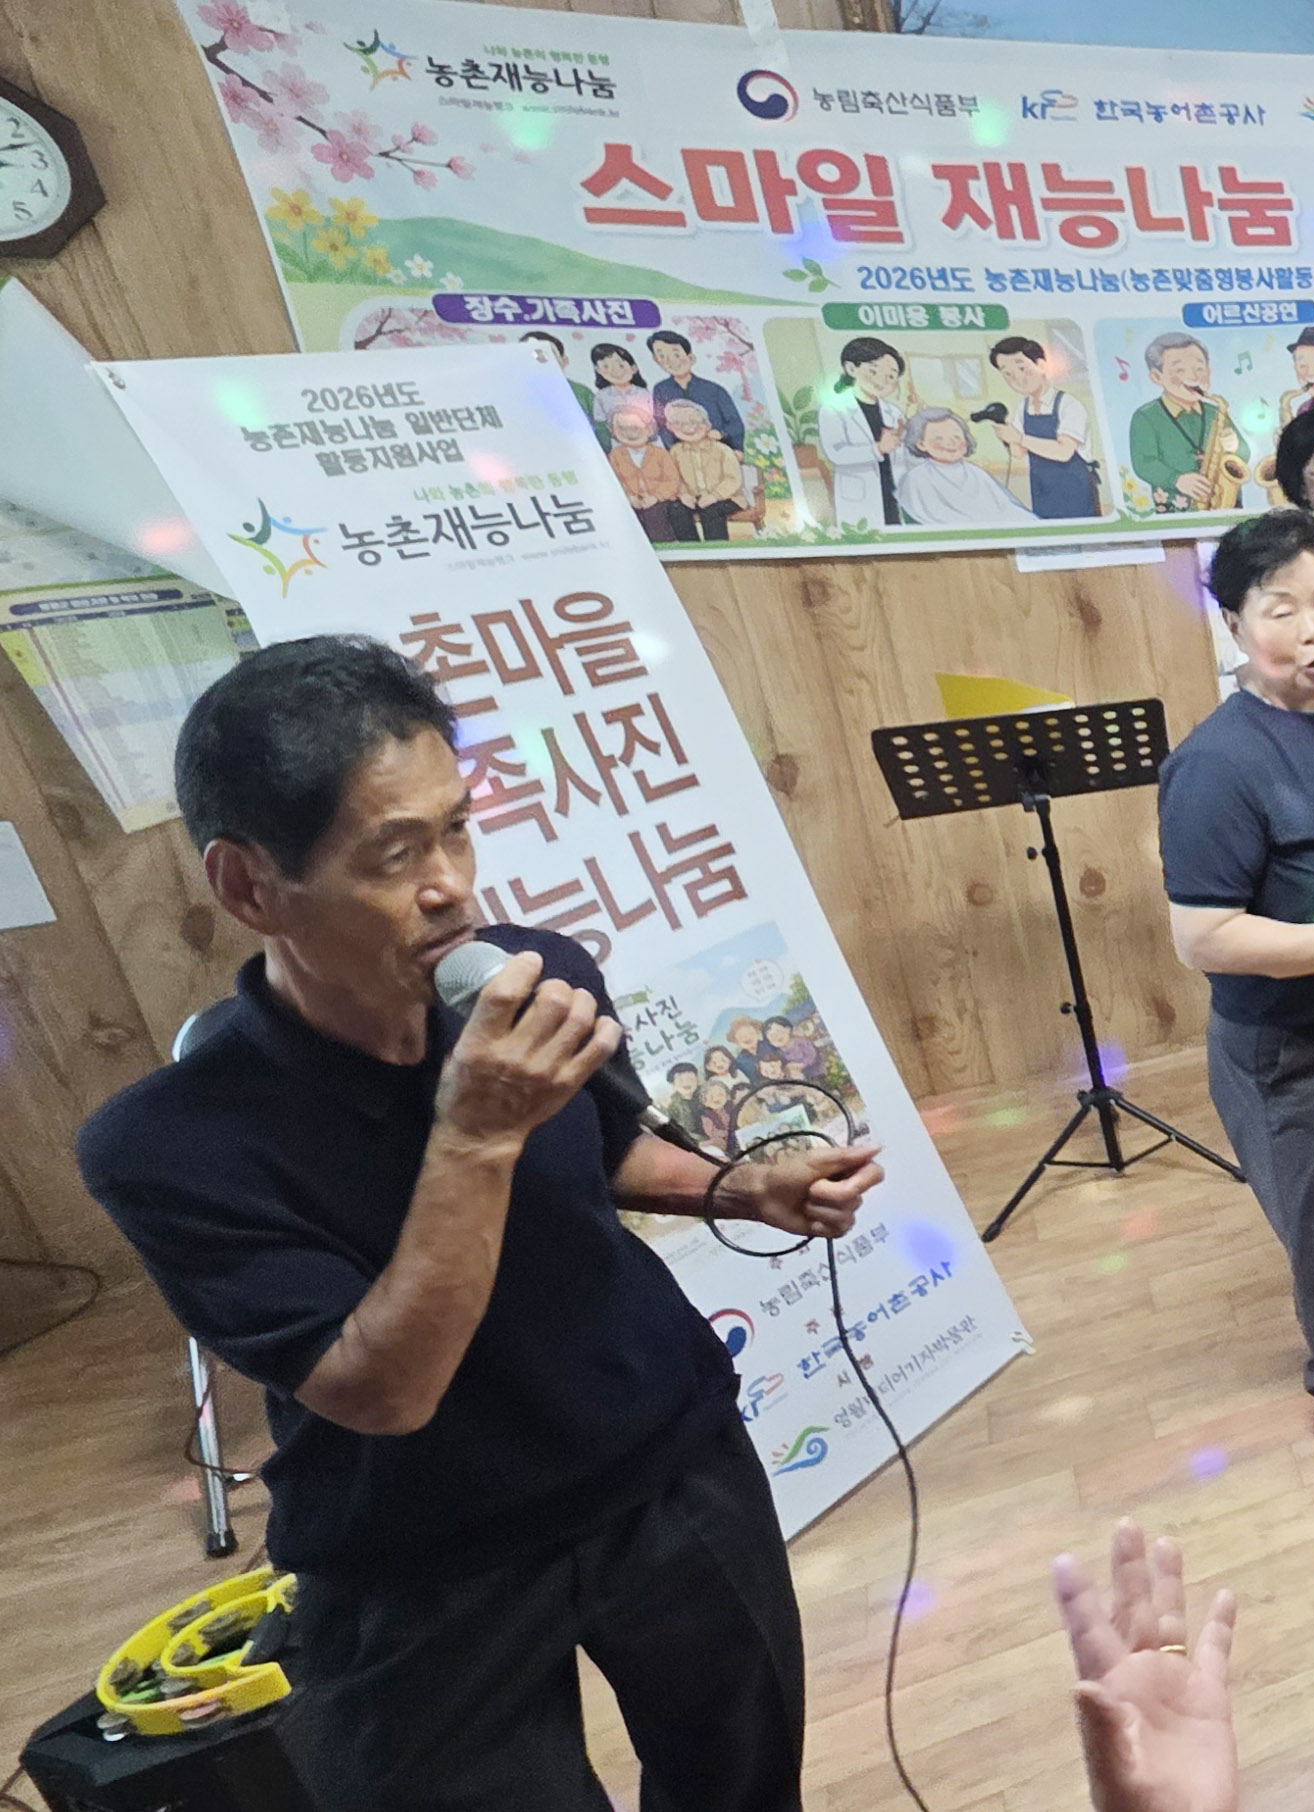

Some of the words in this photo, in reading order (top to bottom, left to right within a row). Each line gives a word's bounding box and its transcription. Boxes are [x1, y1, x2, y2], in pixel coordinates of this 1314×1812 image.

[425, 55, 617, 99] 농촌재능나눔
[812, 86, 981, 118] 농림축산식품부
[1093, 99, 1266, 126] 한국농어촌공사
[7, 117, 25, 138] 2
[31, 149, 49, 170] 3
[30, 178, 49, 198] 4
[580, 142, 906, 244] 스마일
[931, 159, 1295, 250] 재능나눔
[12, 200, 33, 222] 5
[857, 264, 973, 293] 2026년도
[464, 295, 636, 327] 장수.가족사진
[858, 303, 929, 328] 이미용
[939, 303, 986, 328] 봉사
[1201, 302, 1300, 326] 어르신공연
[301, 380, 425, 414] 2026년도
[241, 414, 398, 454] 농촌재능나눔
[404, 404, 504, 437] 일반단체
[315, 438, 465, 478] 활동지원사업
[341, 493, 597, 567] 농촌재능나눔
[399, 591, 649, 719] 촌마을
[461, 692, 701, 842] 족사진
[472, 821, 749, 963] 능나눔
